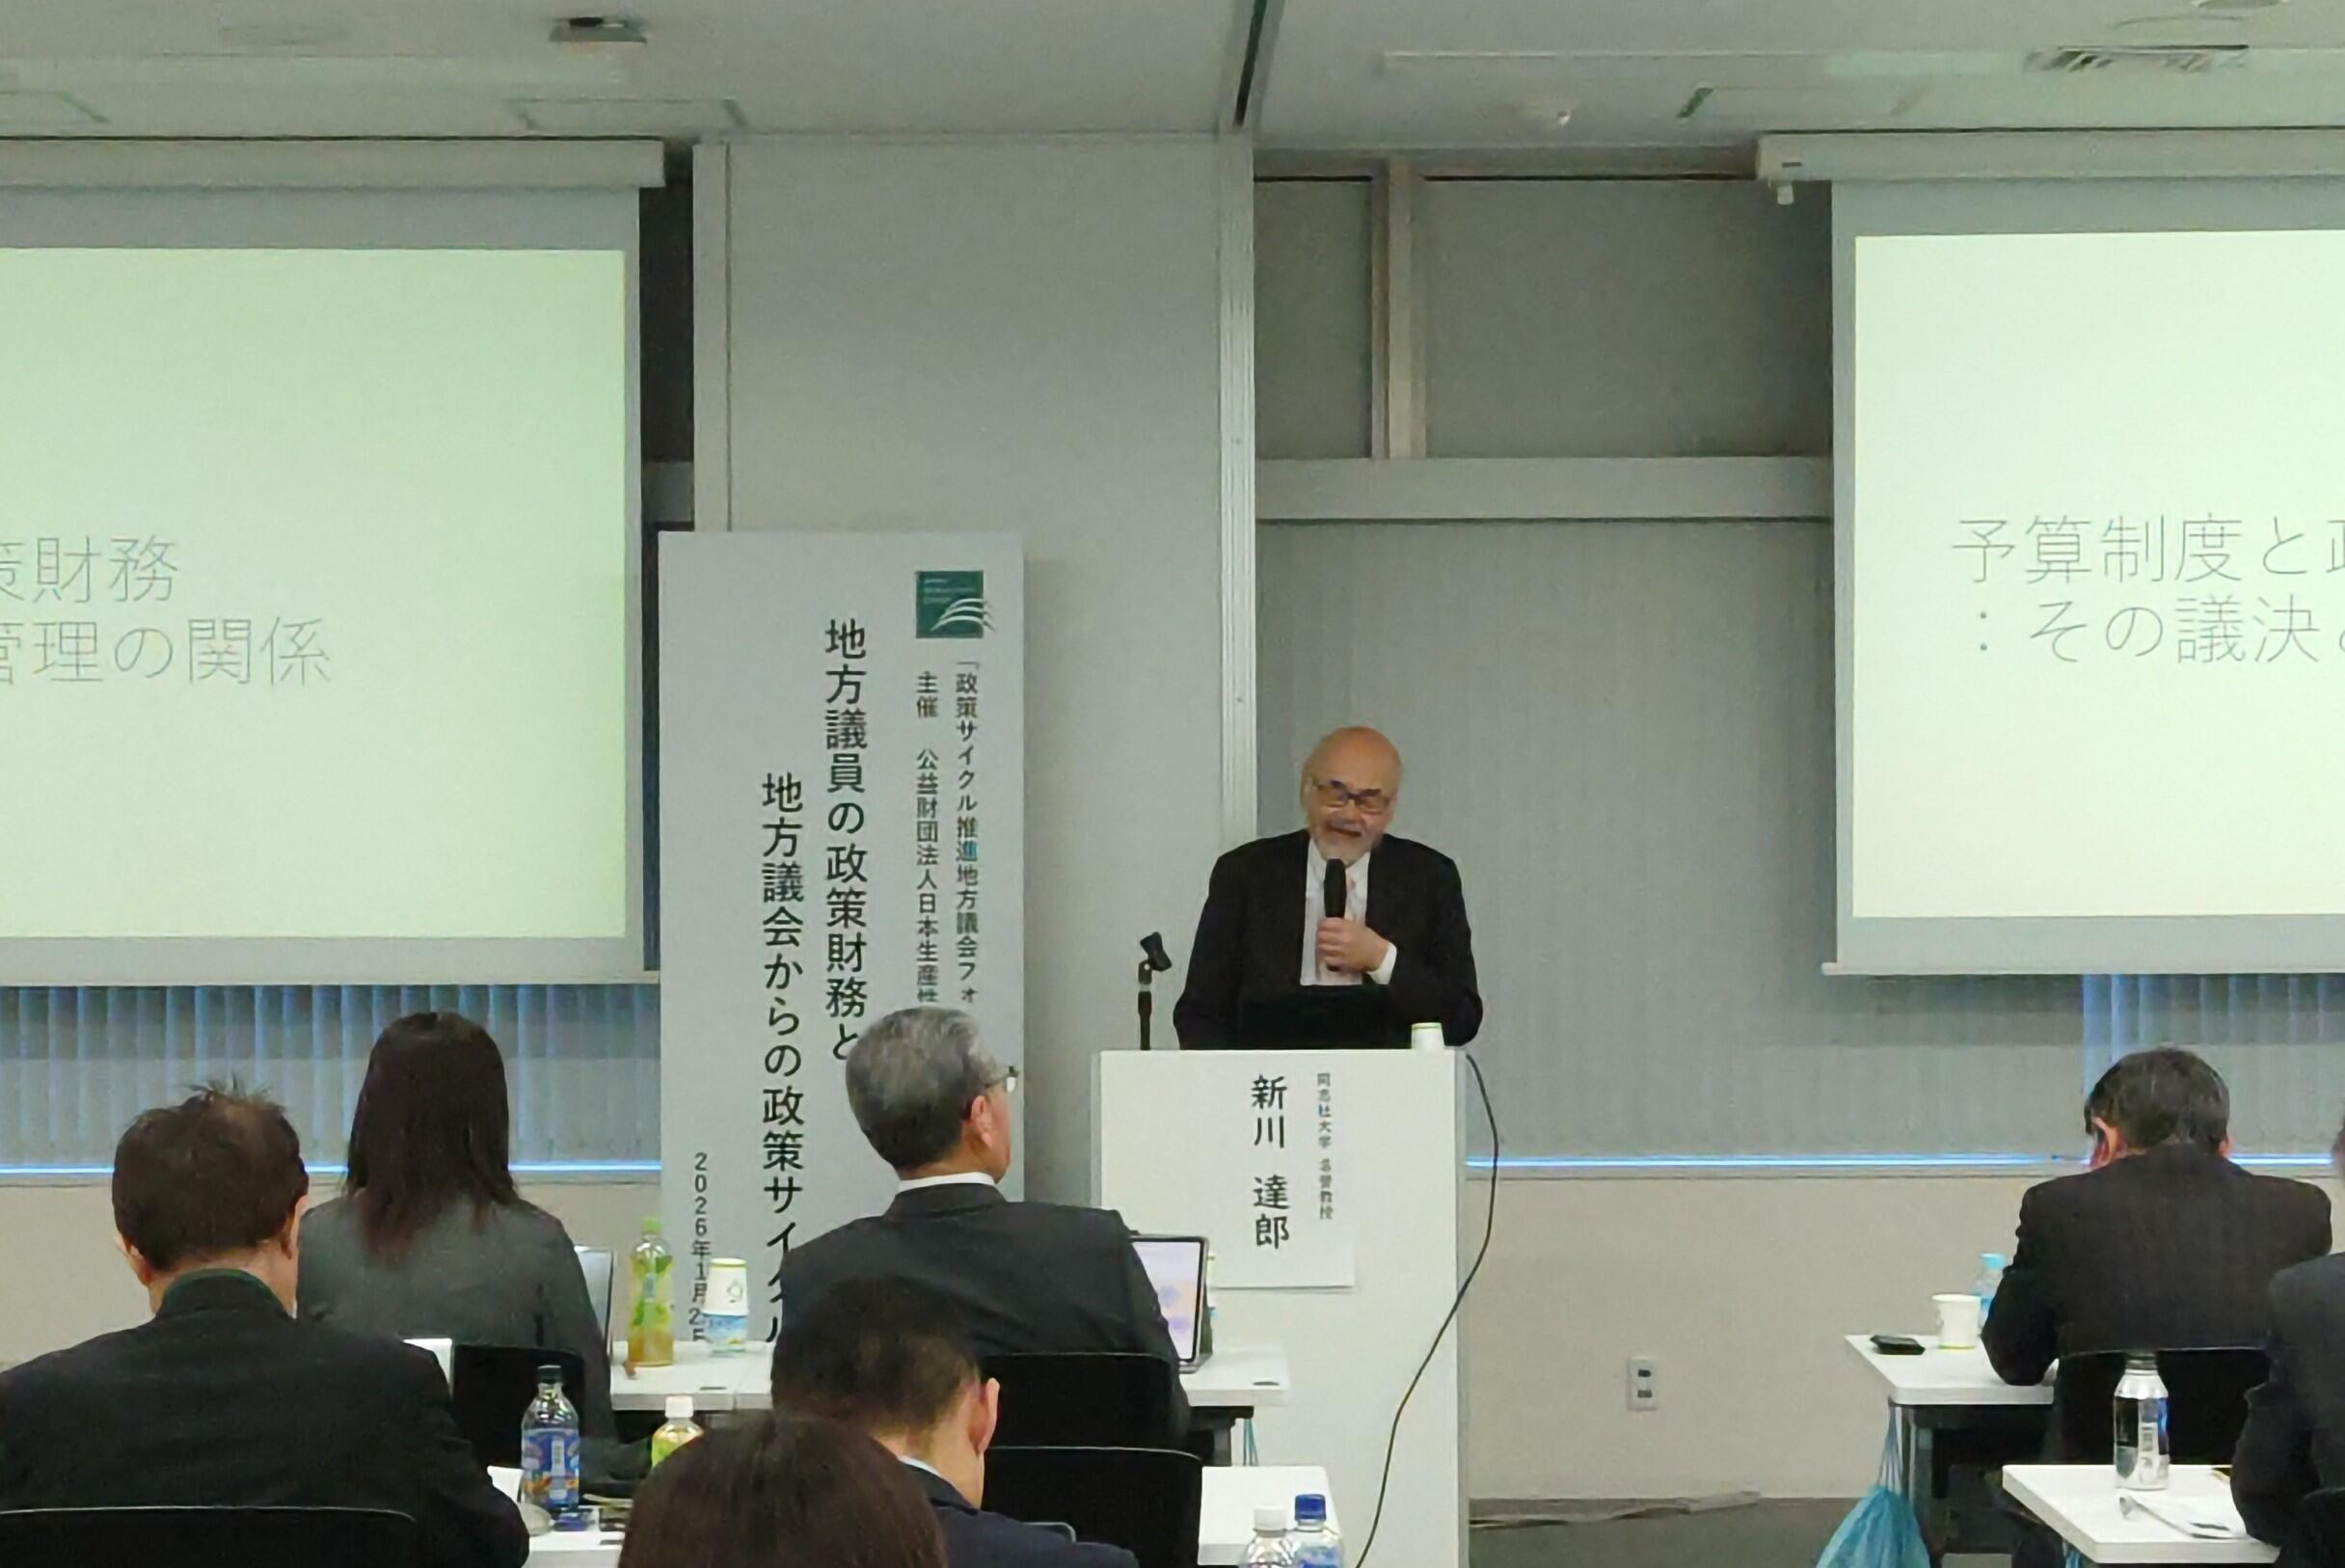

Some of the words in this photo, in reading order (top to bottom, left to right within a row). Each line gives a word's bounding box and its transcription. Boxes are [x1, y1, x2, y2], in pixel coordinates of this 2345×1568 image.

[1952, 513, 2345, 584] 予算制度と
[1980, 593, 2345, 663] ：その議決
[916, 670, 939, 718] 主催
[824, 618, 868, 1061] 地方議員の政策財務と
[1252, 1073, 1288, 1149] 新川
[1253, 1174, 1290, 1250] 達郎
